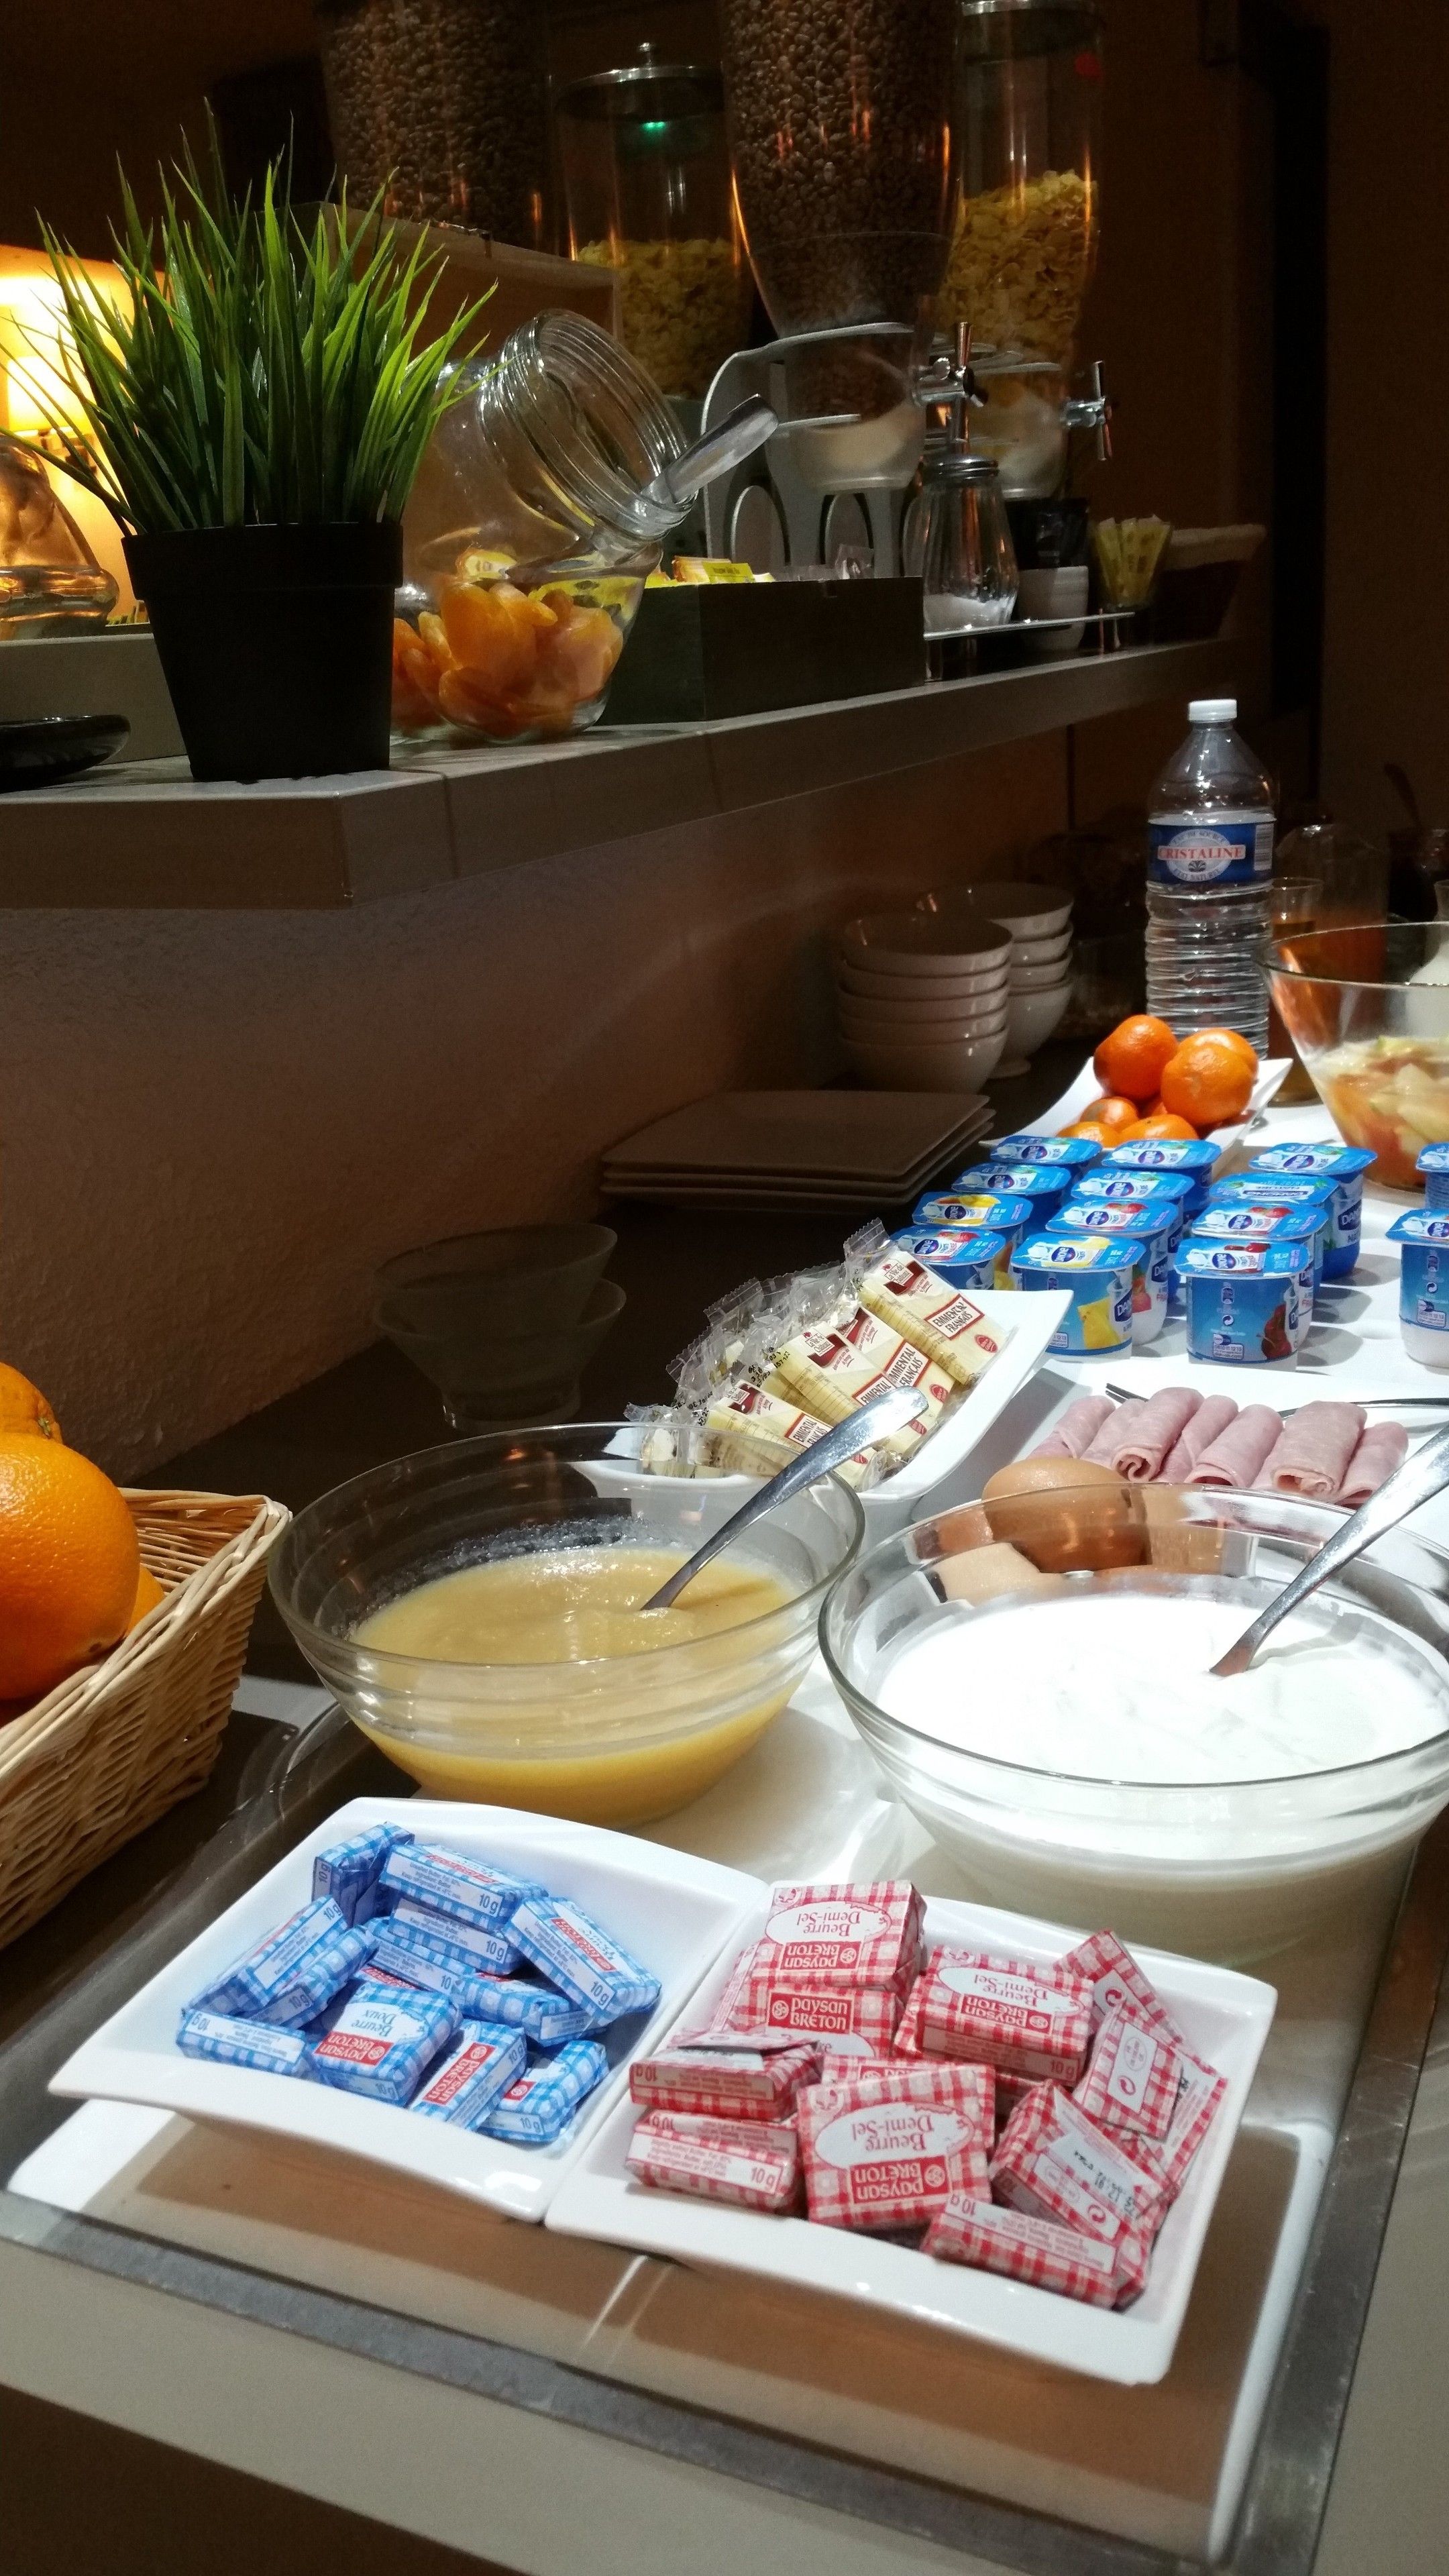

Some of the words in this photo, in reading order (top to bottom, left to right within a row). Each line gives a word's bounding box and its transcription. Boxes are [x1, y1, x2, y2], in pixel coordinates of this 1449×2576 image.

[318, 1872, 328, 1883] 10
[479, 1894, 490, 1909] 10
[323, 1908, 334, 1921] 10
[796, 1911, 860, 1925] Demi-Sel
[804, 1923, 850, 1936] Beurre
[486, 1940, 496, 1955] 10
[441, 1975, 451, 1990] 10
[590, 1981, 603, 1996] 10
[974, 1974, 1048, 2000] Demi-Sel
[983, 1985, 1038, 2006] Beurre
[365, 2009, 396, 2021] Doux
[198, 2018, 211, 2031] 10
[351, 2019, 393, 2037] Beurre
[1050, 2061, 1063, 2074] 10
[521, 2117, 533, 2129] 10
[851, 2114, 934, 2141] Demi-Sel
[865, 2133, 927, 2151] Beurre
[751, 2167, 765, 2184] 10
[961, 2198, 976, 2216] 10
